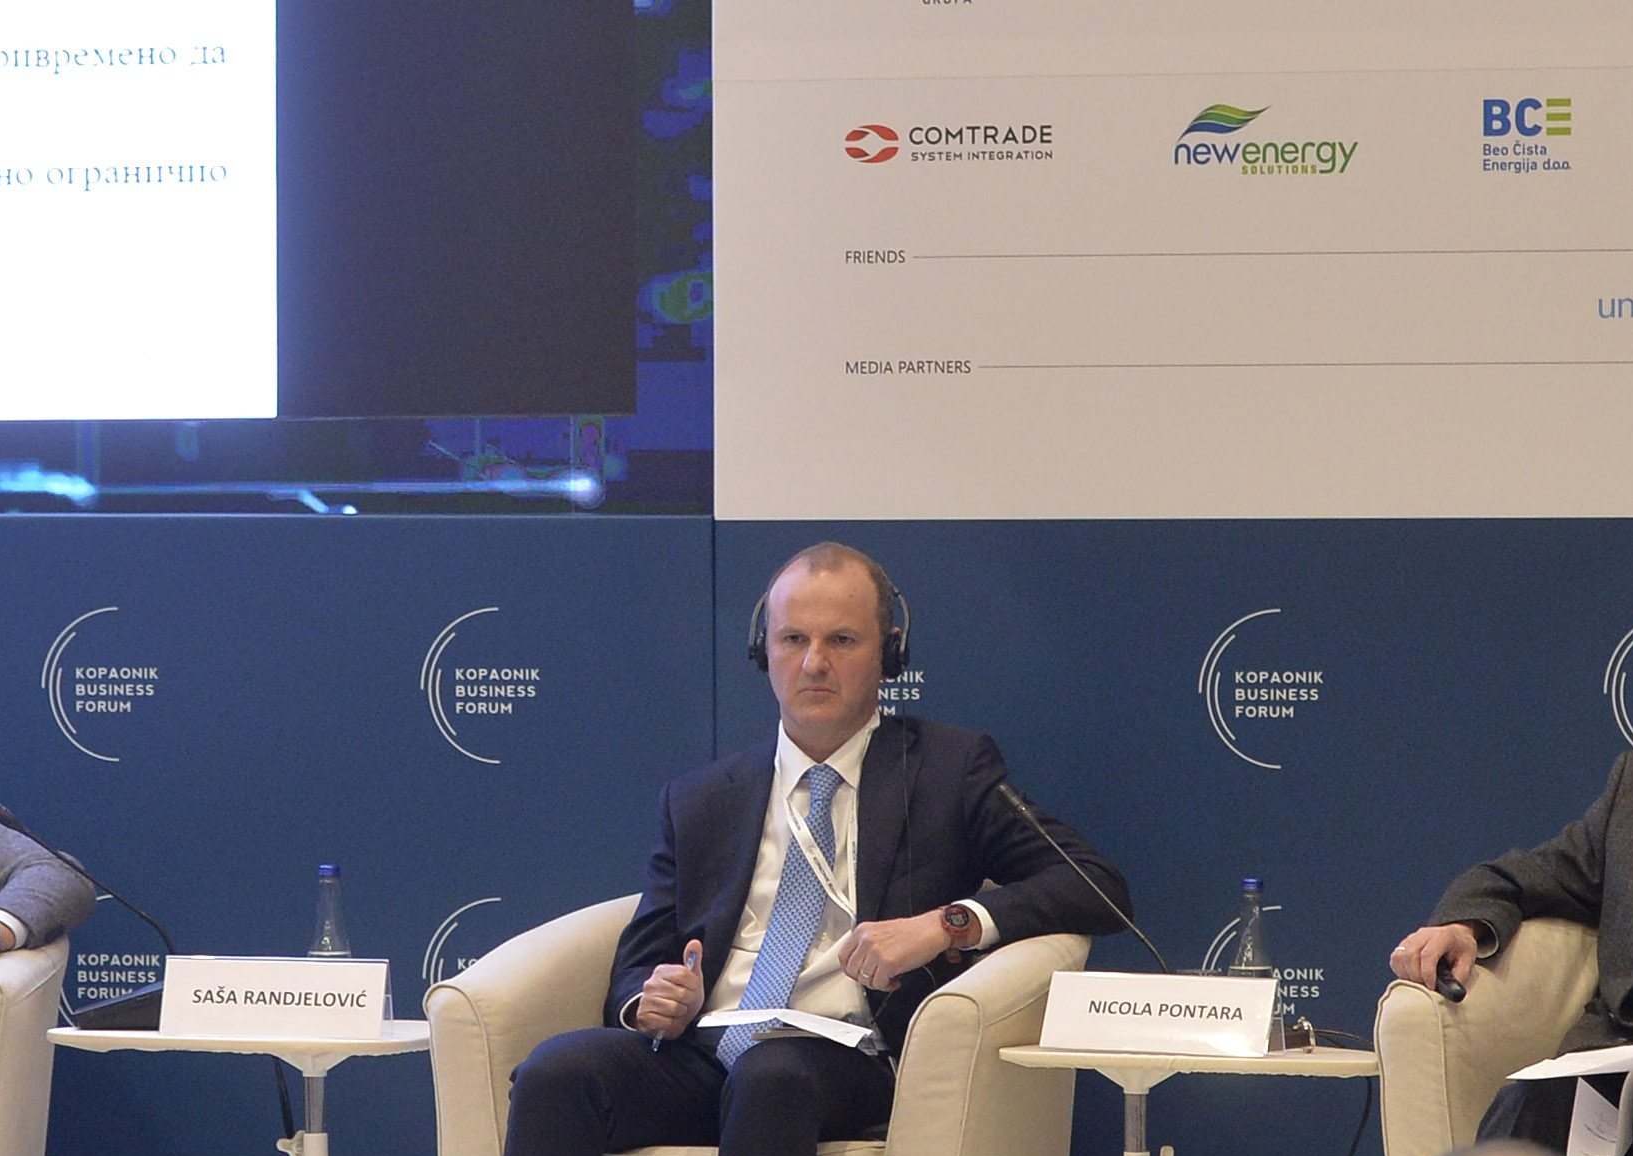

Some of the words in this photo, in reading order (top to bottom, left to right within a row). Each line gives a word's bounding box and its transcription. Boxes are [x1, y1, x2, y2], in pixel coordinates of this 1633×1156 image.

[190, 46, 225, 66] да
[909, 125, 1052, 145] COMTRADE
[1483, 144, 1508, 156] Beo
[1513, 140, 1547, 155] Čista
[911, 152, 962, 161] SYSTEM
[968, 151, 1052, 160] INTEGRATION
[1242, 165, 1316, 175] SOLUTIONS
[1483, 158, 1537, 173] Energija
[846, 250, 905, 264] FRIENDS
[846, 361, 893, 374] MEDIA
[899, 360, 971, 374] PARTNERS
[76, 668, 158, 679] KOPAONIK
[456, 669, 539, 680] KOPAONIK
[1236, 672, 1323, 683] KOPAONIK
[76, 684, 154, 695] BUSINESS
[456, 686, 535, 697] BUSINESS
[878, 688, 920, 700] NESS
[1235, 689, 1318, 700] BUSINESS
[76, 701, 131, 712] FORUM
[456, 702, 512, 713] FORUM
[1236, 706, 1293, 717] FORUM
[77, 954, 160, 966] KOPAONIK
[77, 971, 156, 983] BUSINESS
[1273, 968, 1324, 980] AONIK
[192, 985, 238, 1004] SAŠA
[243, 989, 367, 1007] RANDJELOVIĆ
[1278, 985, 1320, 998] NESS
[1088, 1000, 1153, 1016] NICOLA
[1158, 1003, 1243, 1020] PONTARA
